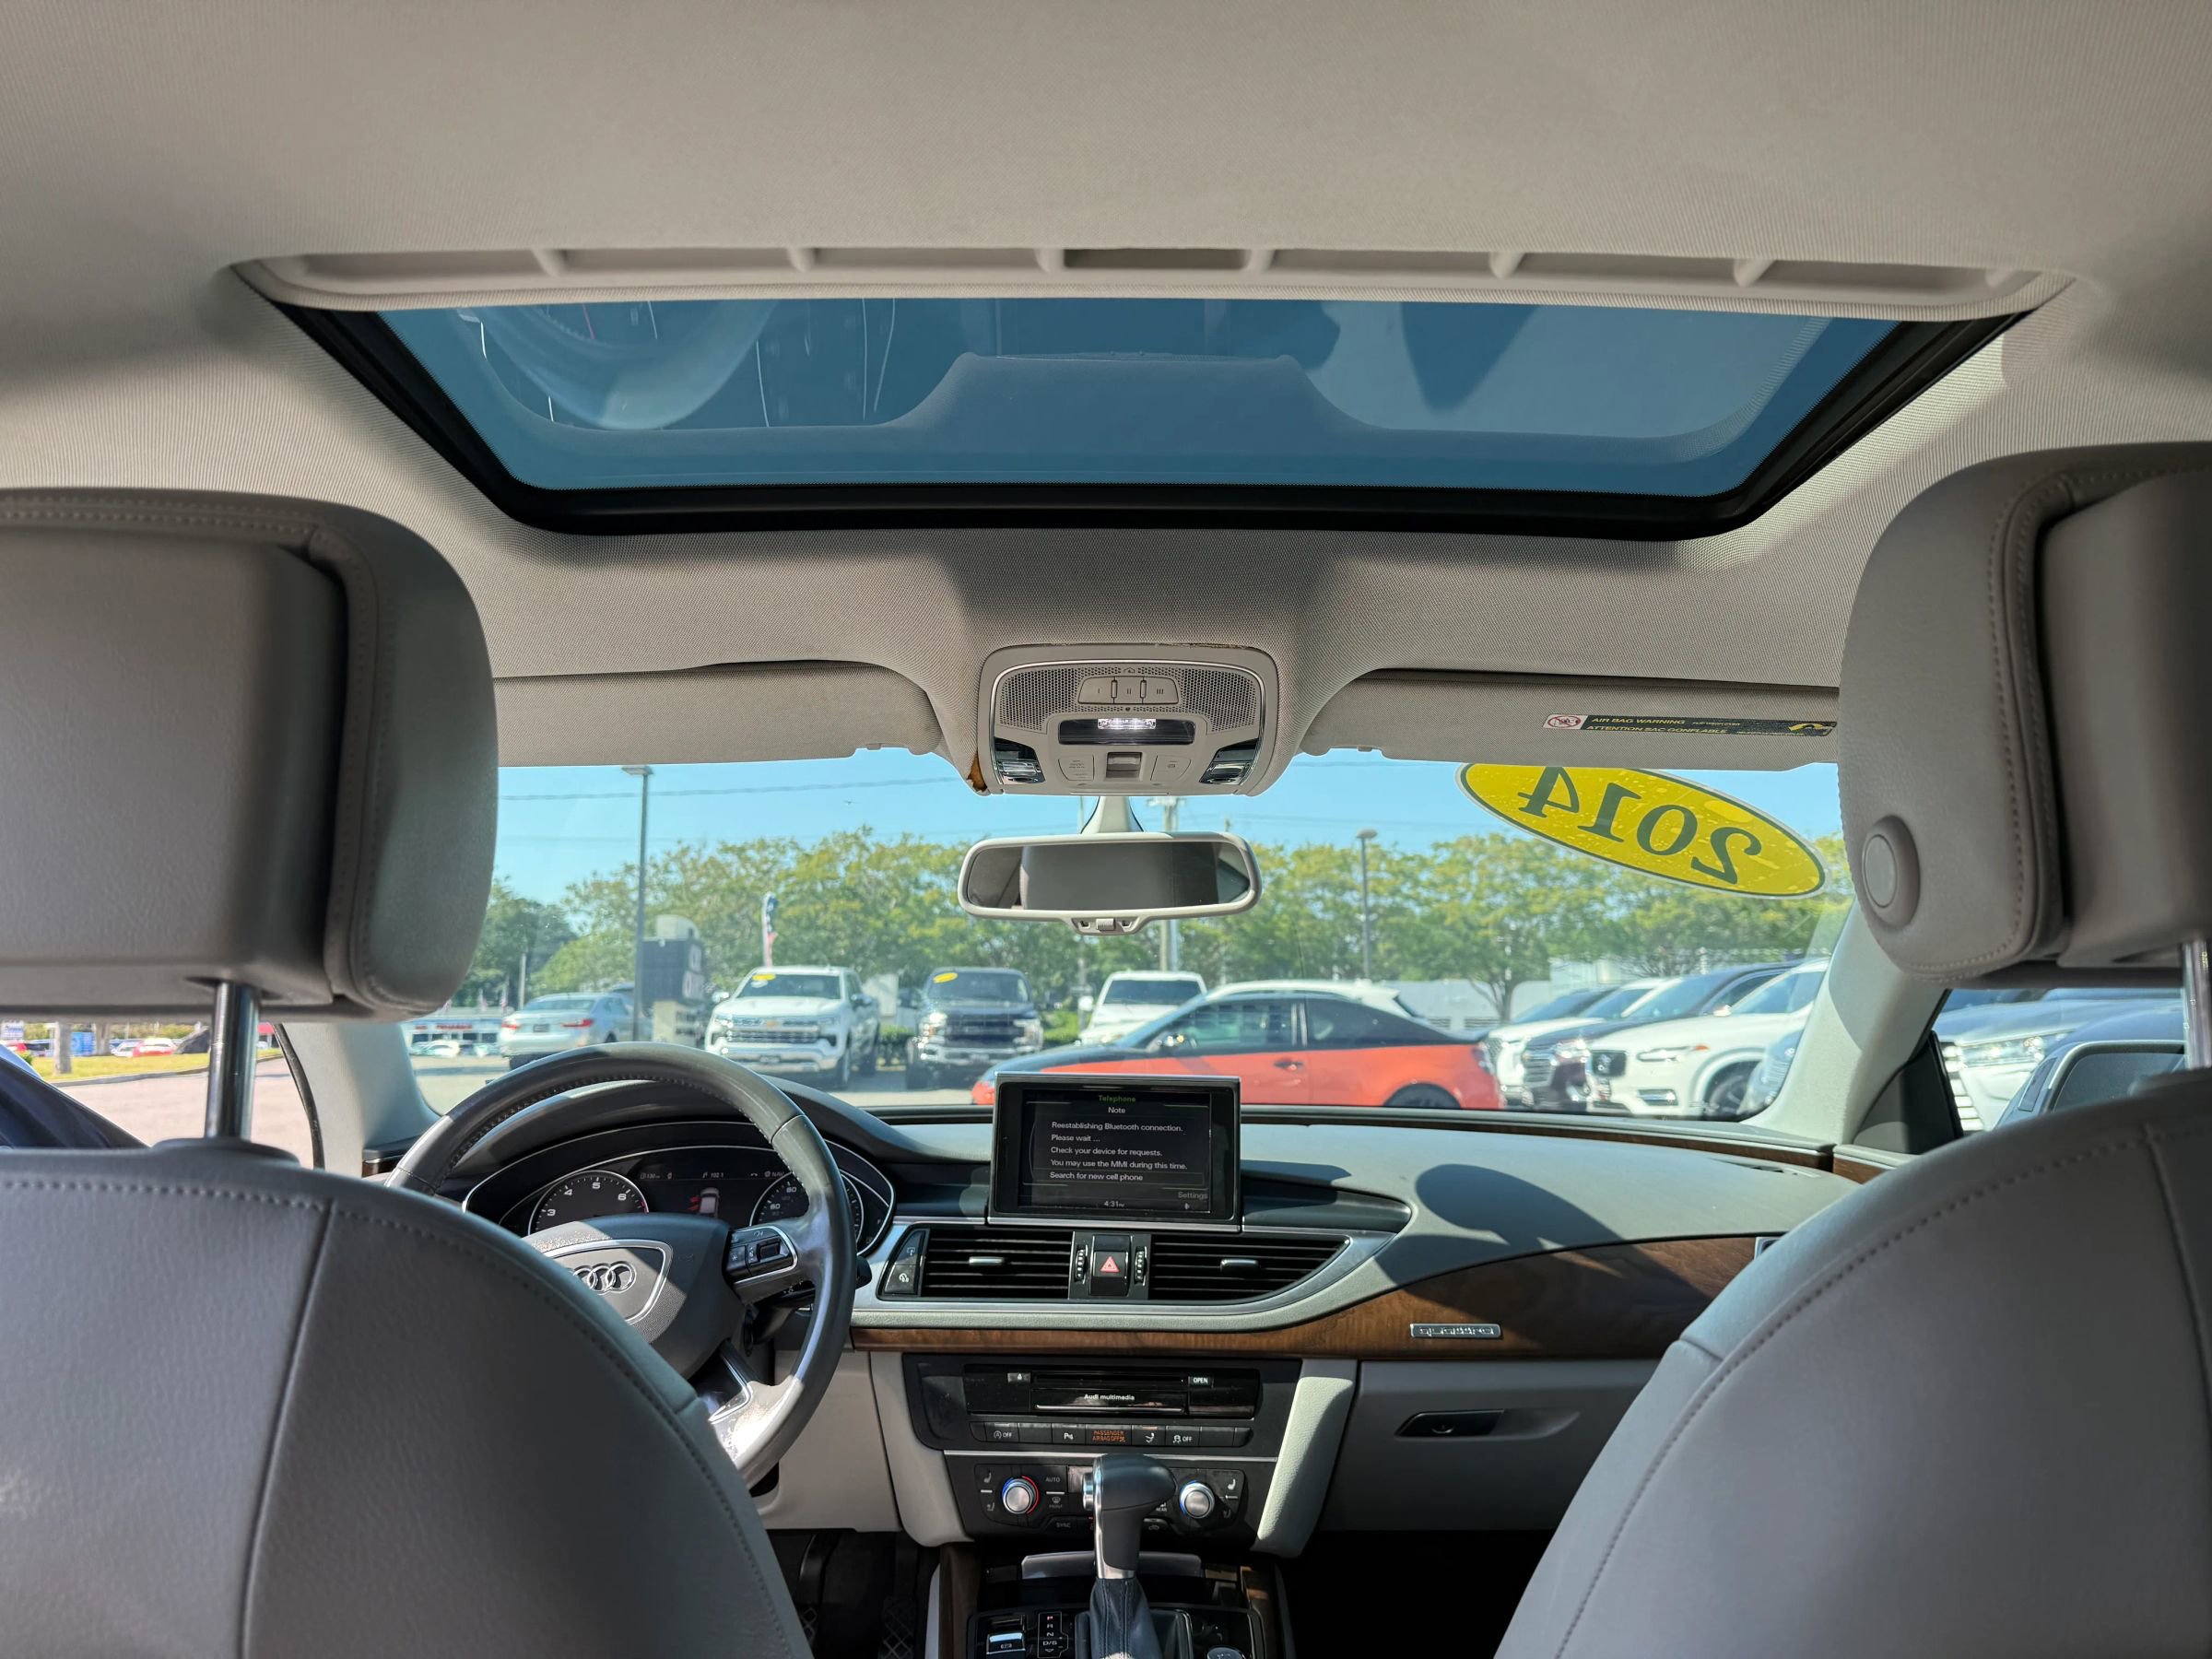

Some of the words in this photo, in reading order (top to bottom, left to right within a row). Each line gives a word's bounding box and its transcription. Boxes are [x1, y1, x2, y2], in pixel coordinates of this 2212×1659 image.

[1098, 1094, 1136, 1104] Telephone
[1108, 1106, 1126, 1114] Note
[1052, 1121, 1103, 1131] Reestablishing
[1104, 1122, 1139, 1131] Bluetooth
[1140, 1124, 1183, 1132] connection.
[1051, 1134, 1075, 1142] Please
[1050, 1146, 1073, 1154] Check
[1075, 1147, 1090, 1156] your
[1092, 1147, 1116, 1155] device
[1117, 1147, 1128, 1156] for
[1129, 1149, 1163, 1158] requests.
[1065, 1160, 1081, 1169] may
[1129, 1161, 1153, 1171] during
[1154, 1161, 1168, 1170] this
[1169, 1162, 1188, 1171] time.
[1050, 1171, 1075, 1180] Search
[1119, 1173, 1144, 1182] phone
[592, 1182, 601, 1190] 5
[618, 1193, 627, 1201] 6
[1177, 1191, 1208, 1200] Settings
[547, 1208, 556, 1217] 3
[1193, 1376, 1208, 1384] OPEN
